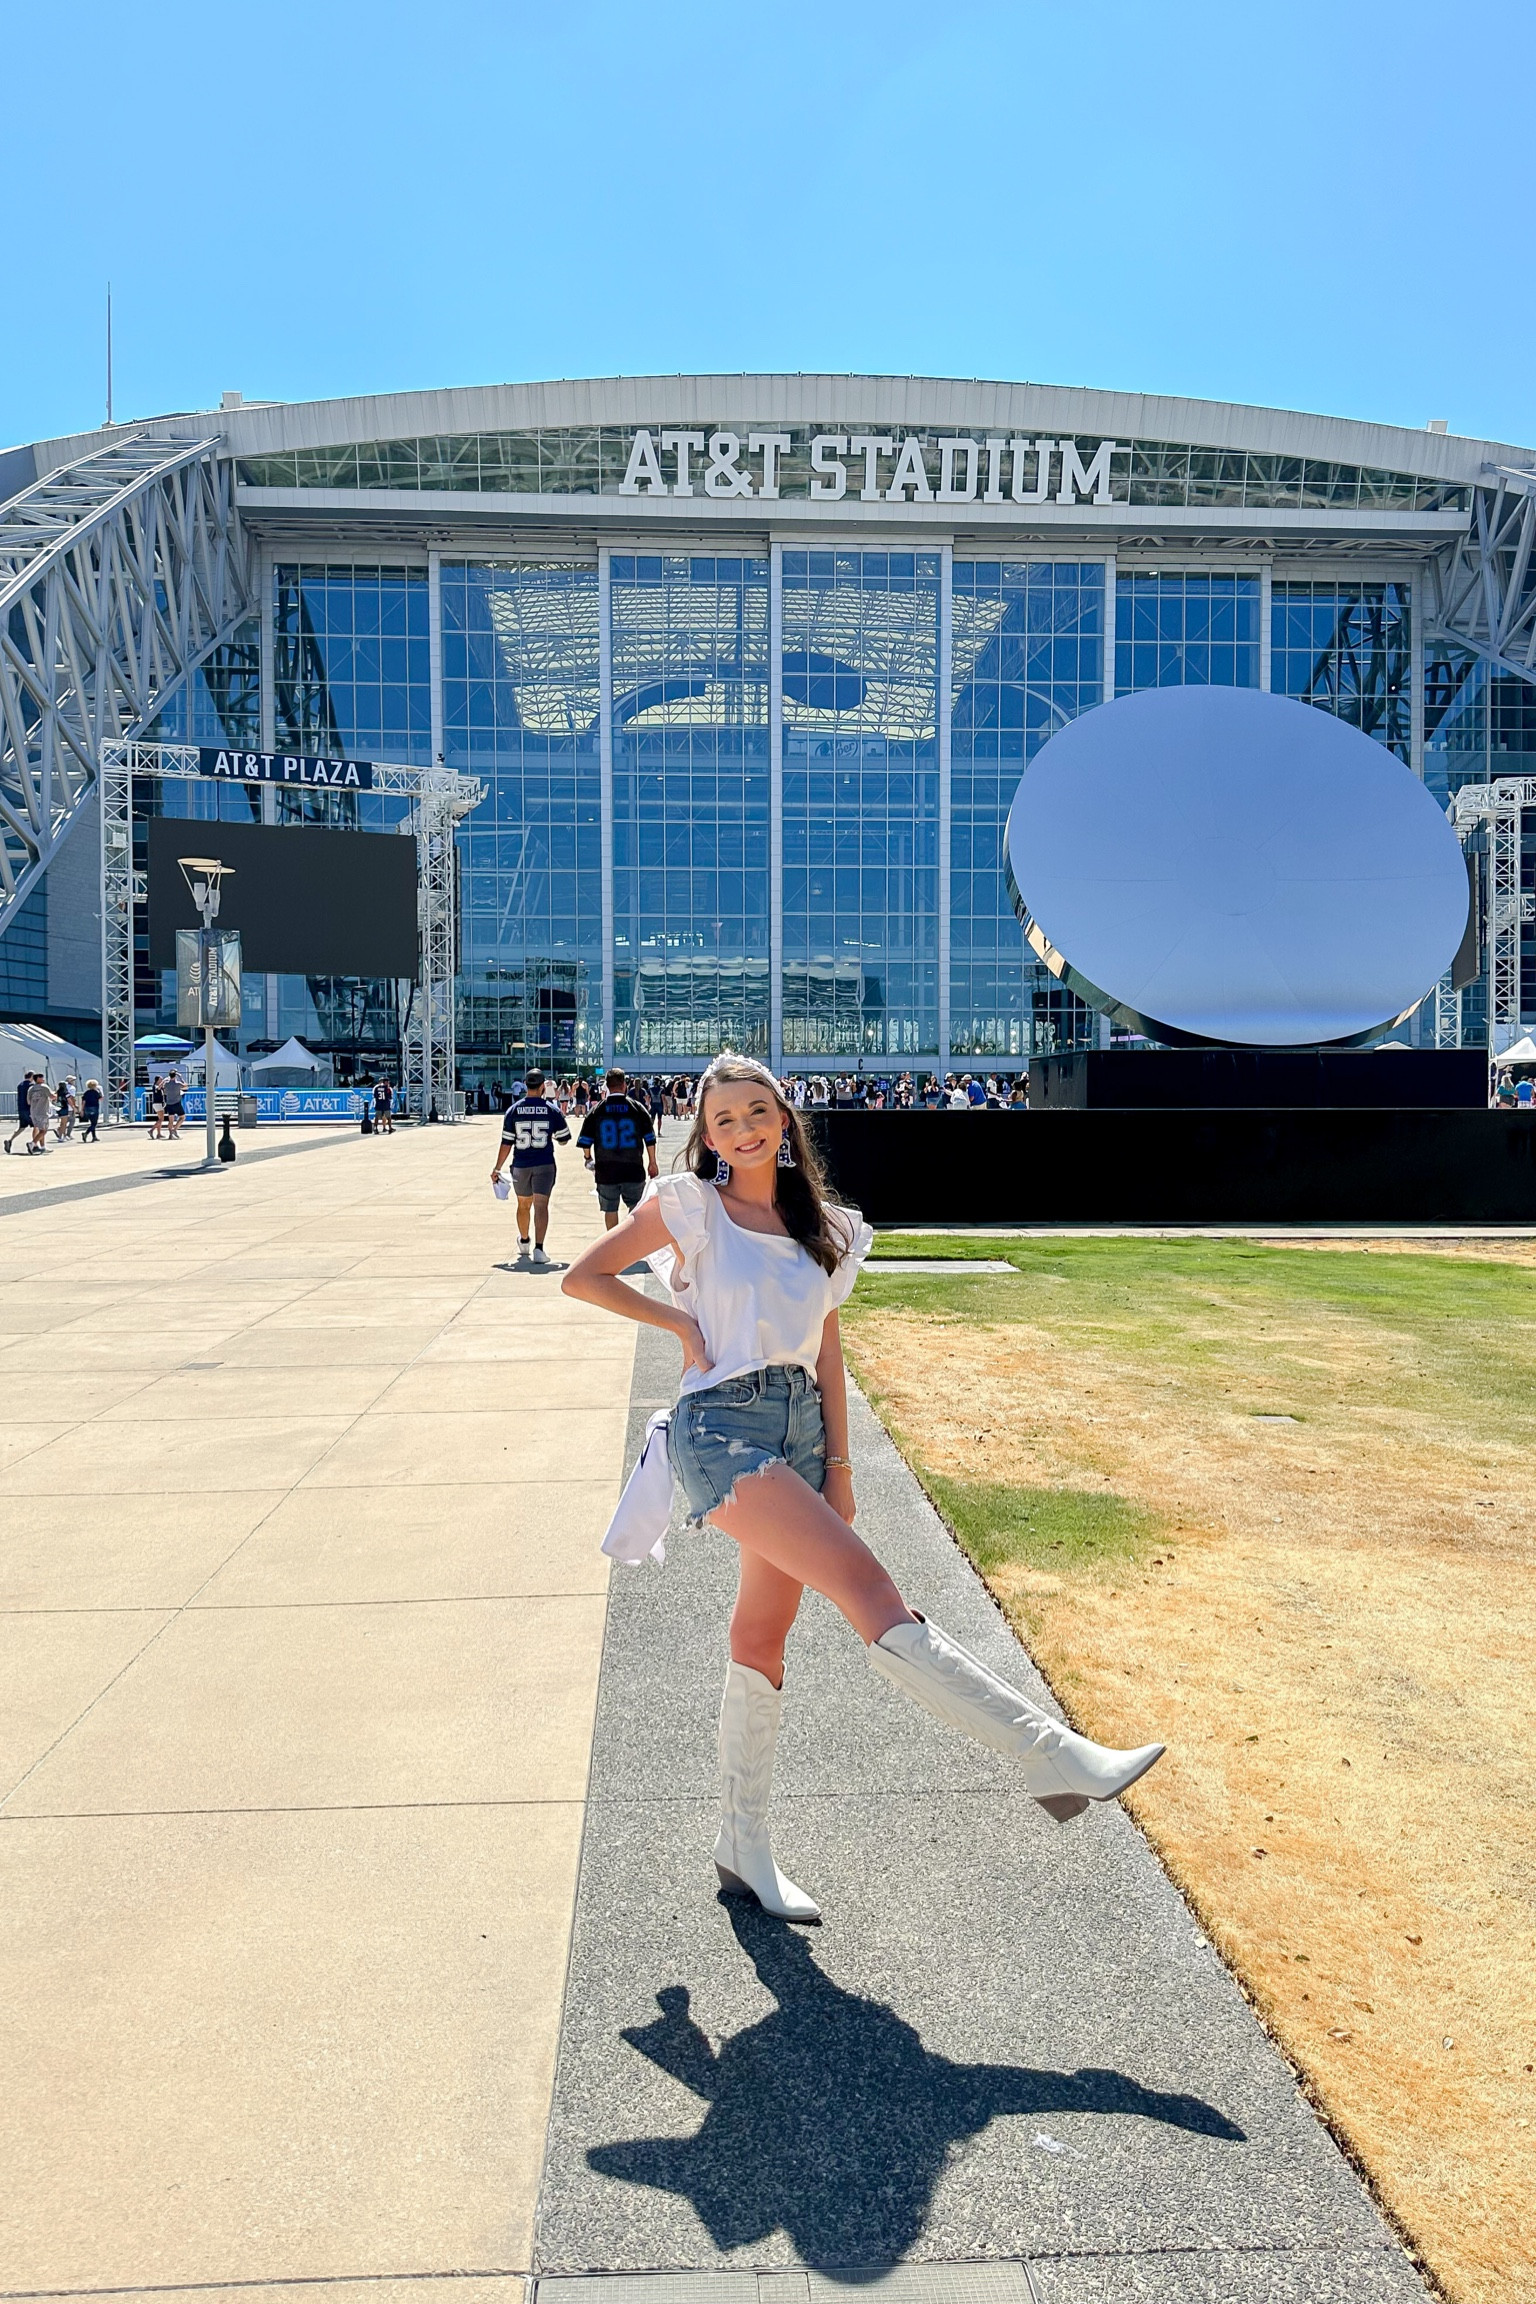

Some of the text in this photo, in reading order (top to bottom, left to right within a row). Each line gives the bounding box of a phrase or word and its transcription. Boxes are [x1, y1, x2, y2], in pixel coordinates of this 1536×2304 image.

[618, 430, 1117, 505] AT&T STADIUM
[213, 751, 361, 786] AT&T PLAZA
[187, 986, 200, 996] AT
[208, 946, 218, 1007] AT&T STADIUM
[858, 1058, 864, 1070] C
[303, 1098, 341, 1111] AT&T
[514, 1120, 550, 1149] 55
[600, 1118, 637, 1148] 82
